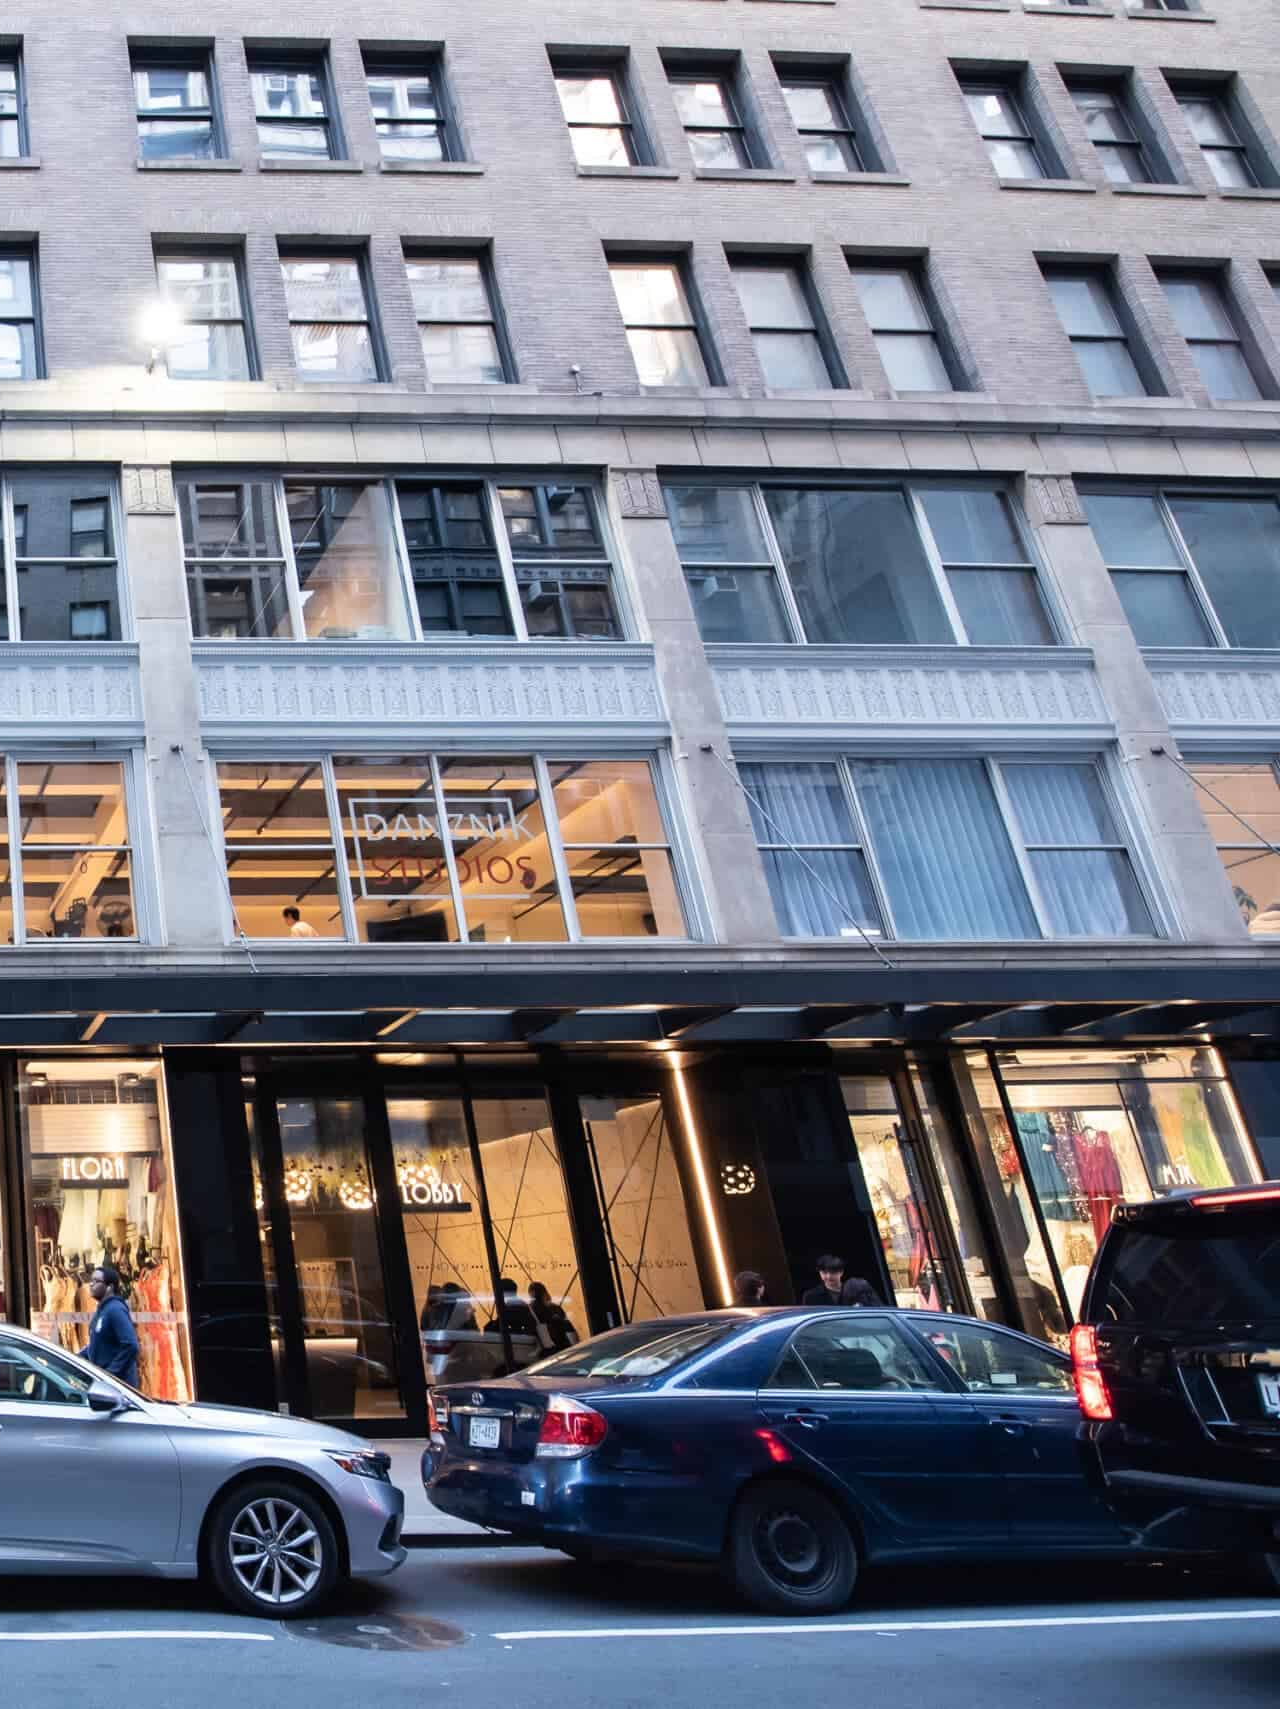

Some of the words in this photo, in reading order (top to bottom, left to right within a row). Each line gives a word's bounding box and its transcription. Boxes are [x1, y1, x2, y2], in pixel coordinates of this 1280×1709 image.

[363, 813, 537, 841] DANZNIK
[62, 1157, 126, 1180] FLORA
[400, 1182, 464, 1204] LOBBY
